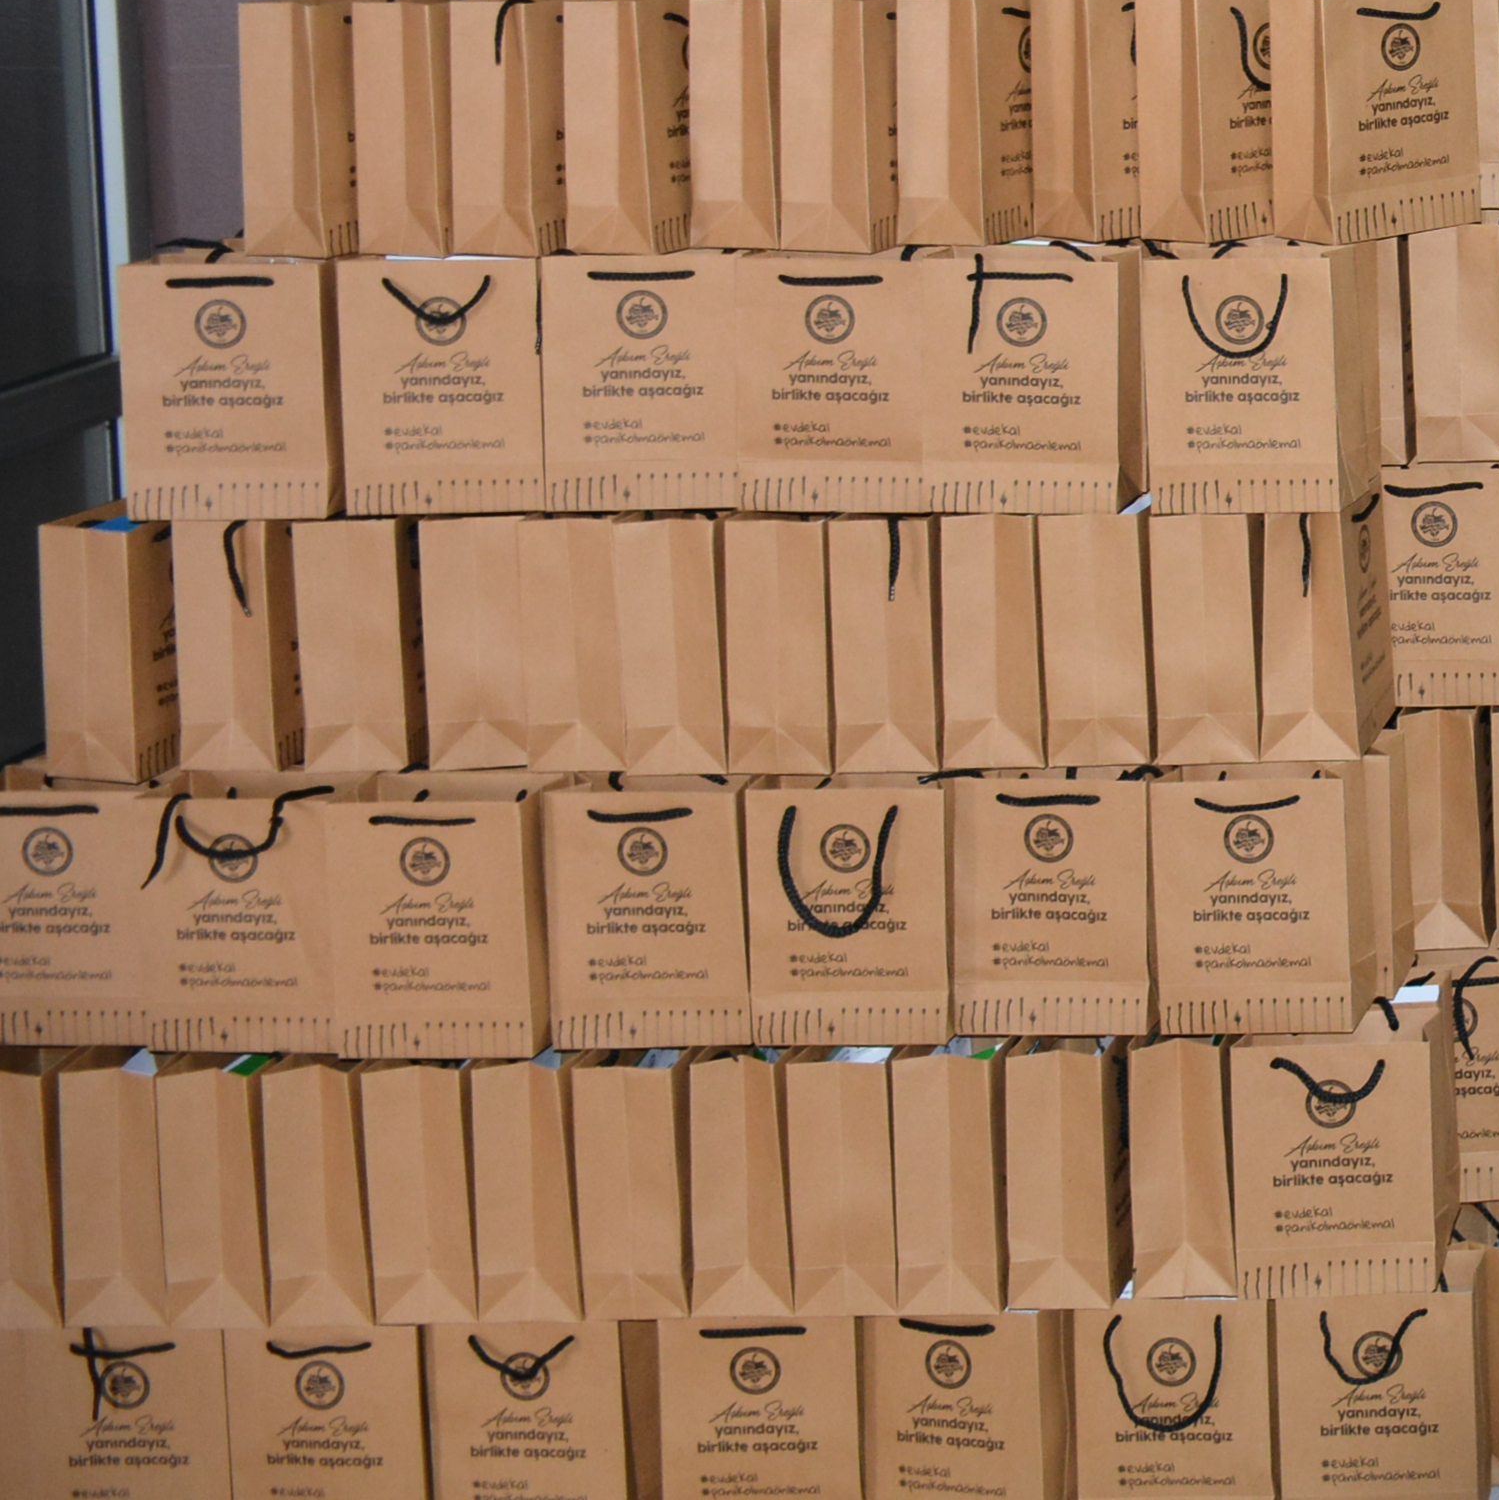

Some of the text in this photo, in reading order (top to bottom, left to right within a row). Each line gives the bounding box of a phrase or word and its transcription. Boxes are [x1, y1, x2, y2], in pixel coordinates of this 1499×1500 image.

[1371, 96, 1435, 115] yanındayız,
[1358, 109, 1449, 131] birlikte aşacağız
[1358, 147, 1403, 161] #evdekal
[400, 374, 485, 388] yanındayız,
[979, 375, 1063, 389] yanındayız,
[382, 390, 504, 405] birlikte aşacağız
[962, 390, 1081, 407] birlikte aşacağız
[383, 424, 442, 435] #evdekal
[962, 424, 1020, 435] #evdekal
[1396, 573, 1474, 586] yanındayız,
[1387, 589, 1491, 603] irlikte aşacağız
[1389, 620, 1434, 630] evdekal
[1390, 633, 1491, 646] panikolmaönlemal
[1209, 892, 1291, 906] yanındayız,
[386, 915, 469, 929] yanındayız,
[1192, 908, 1309, 923] birlikte aşacağız
[369, 931, 488, 946] birlikte aşacağız
[1193, 943, 1250, 954] #evdekal
[371, 966, 429, 976] #evdekal
[1290, 1156, 1374, 1171] yanındayız,
[1272, 1171, 1393, 1187] birlikte aşacağız
[1273, 1206, 1332, 1218] #evdekal
[911, 1416, 988, 1432] yanındayız,
[895, 1430, 1004, 1451] birlikte aşacağız
